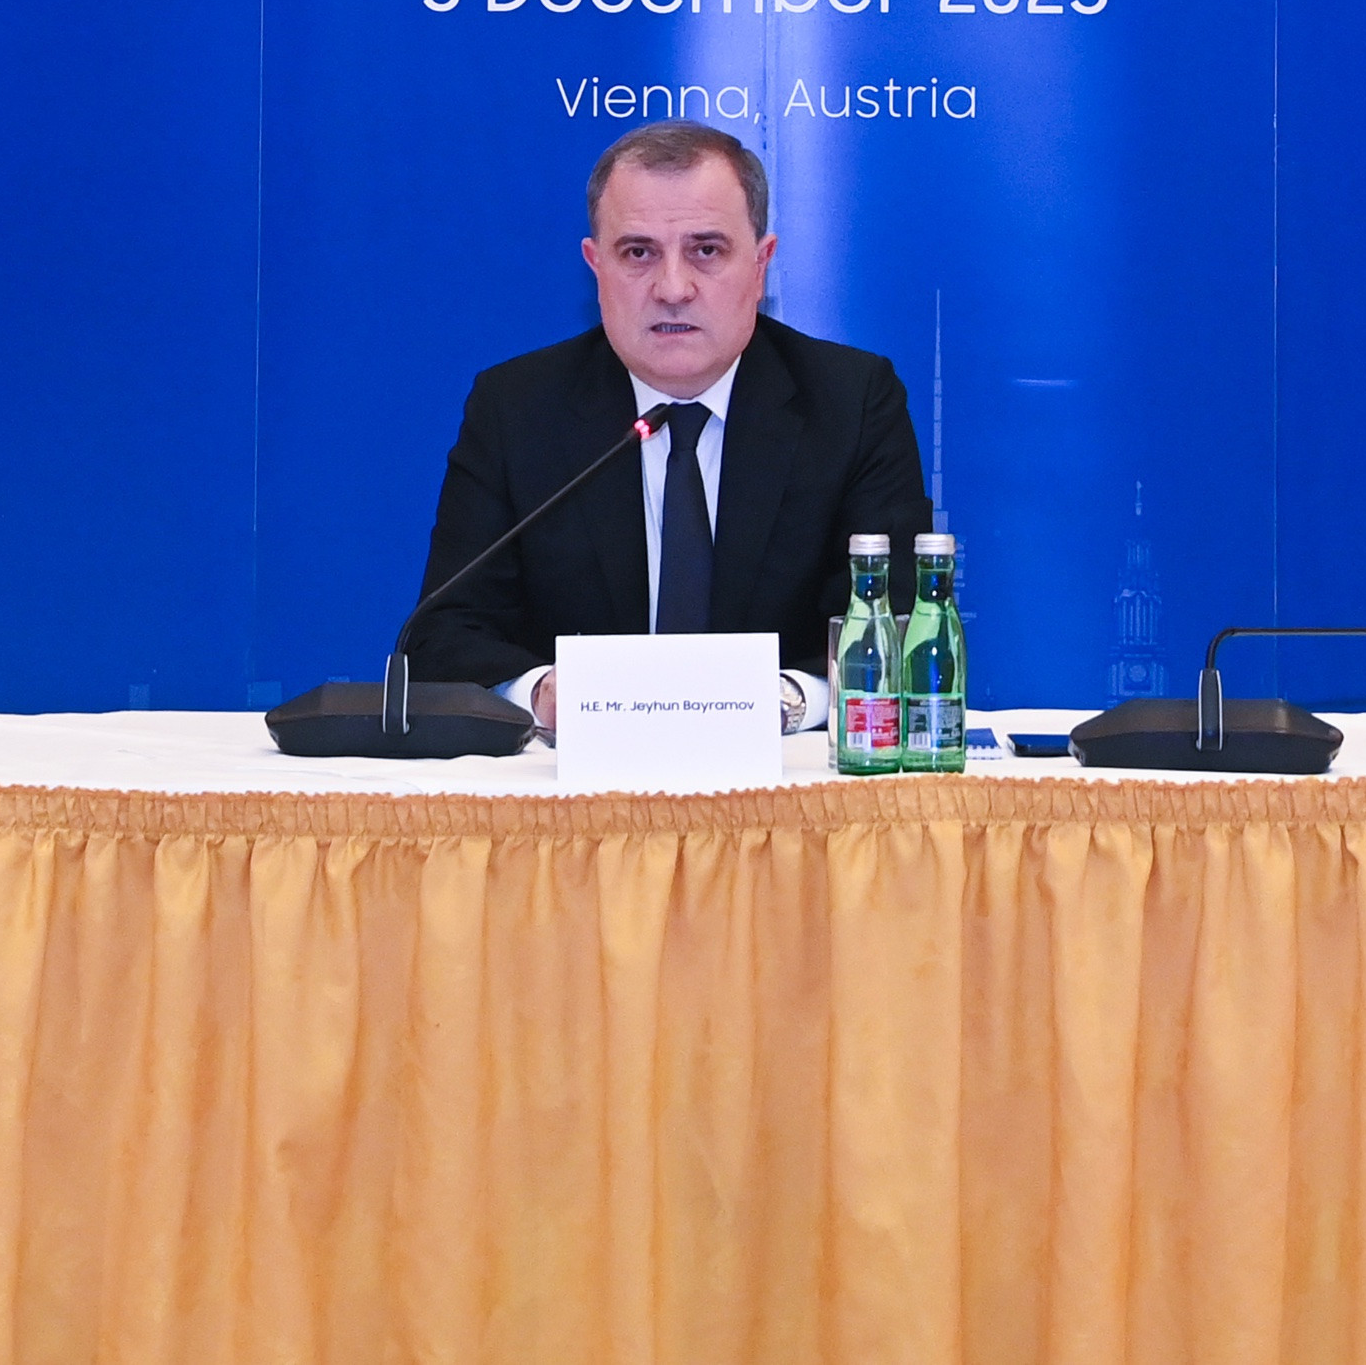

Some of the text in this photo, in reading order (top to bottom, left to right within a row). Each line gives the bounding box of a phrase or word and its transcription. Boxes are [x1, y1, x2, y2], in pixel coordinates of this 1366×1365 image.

[556, 77, 976, 124] Vienna, Austria
[580, 700, 755, 714] H.E. Mr. Jeyhun Bayramov
